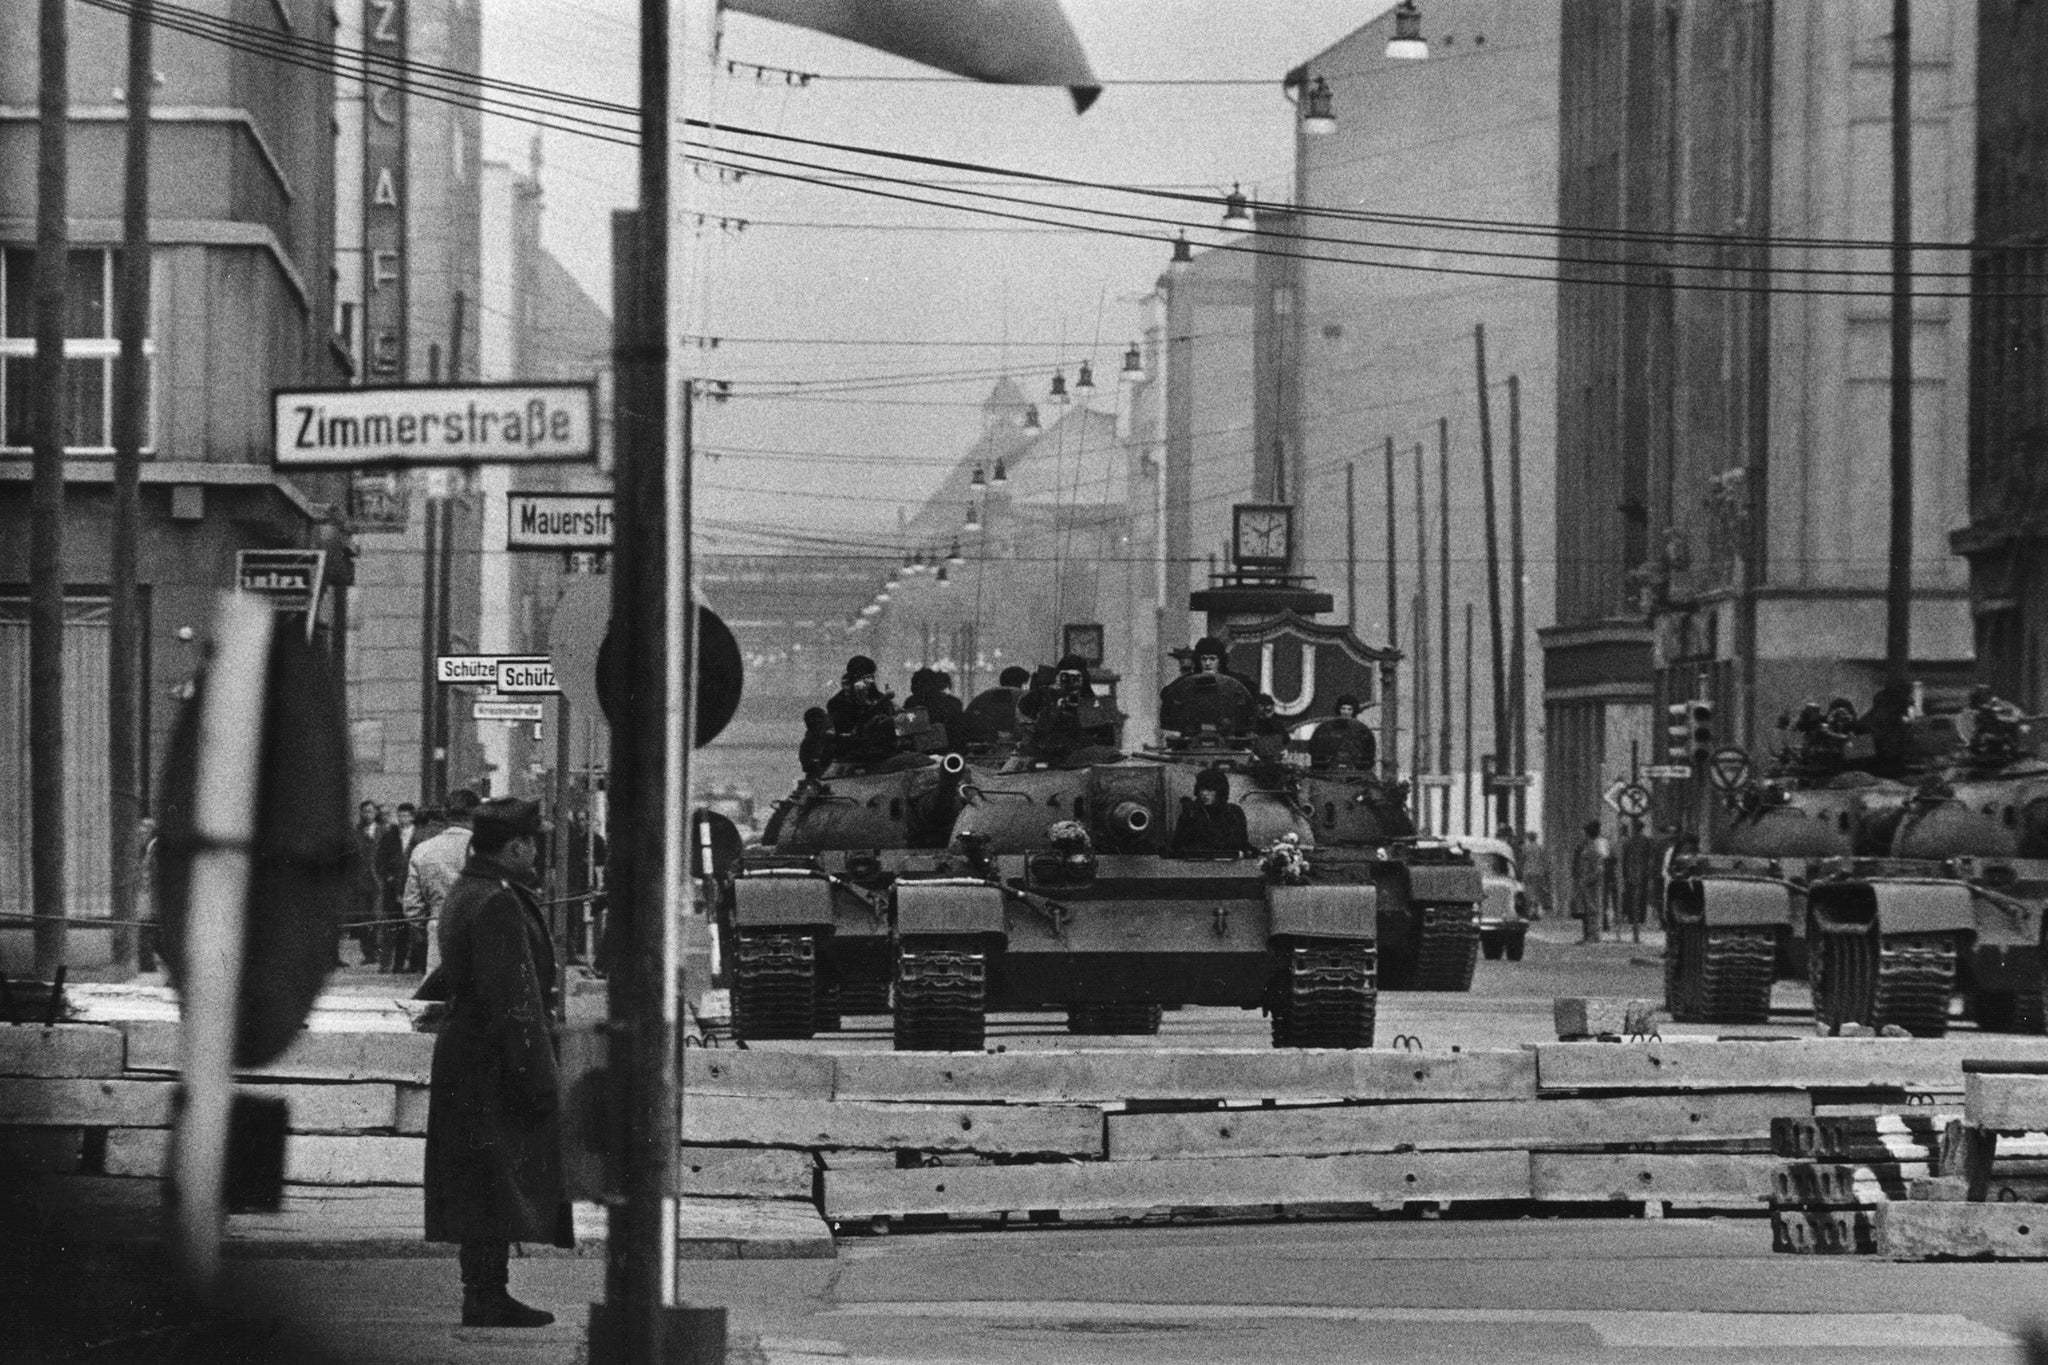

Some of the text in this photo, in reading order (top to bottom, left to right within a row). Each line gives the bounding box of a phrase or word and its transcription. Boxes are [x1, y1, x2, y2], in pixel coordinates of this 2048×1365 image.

[293, 399, 571, 449] Zimmerstraße
[444, 660, 496, 677] Schütze
[505, 667, 556, 686] Schütz
[1260, 643, 1316, 716] U
